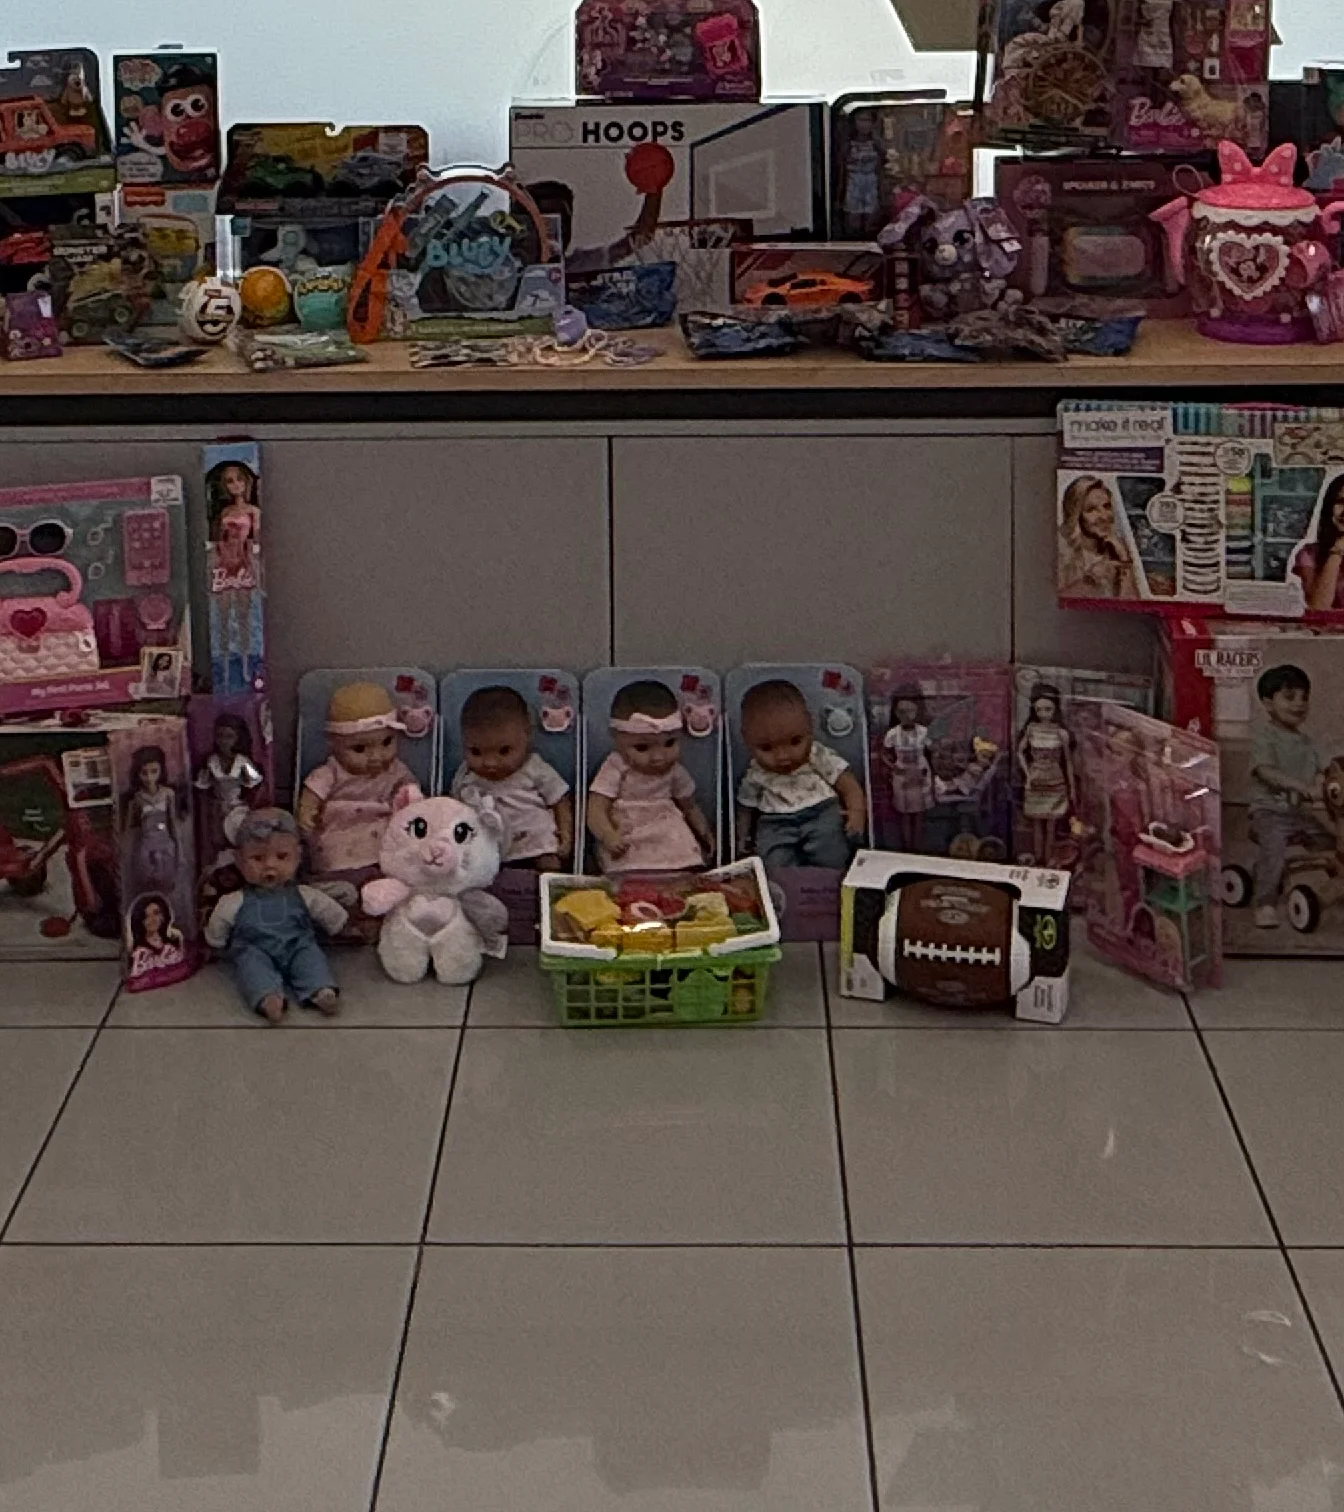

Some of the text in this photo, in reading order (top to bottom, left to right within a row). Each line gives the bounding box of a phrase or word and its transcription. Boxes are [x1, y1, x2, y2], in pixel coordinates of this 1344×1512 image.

[582, 121, 686, 144] HOOPS
[1069, 418, 1119, 433] make
[211, 568, 253, 592] Barbie
[1216, 650, 1261, 667] RACERS
[131, 943, 185, 978] Barbie
